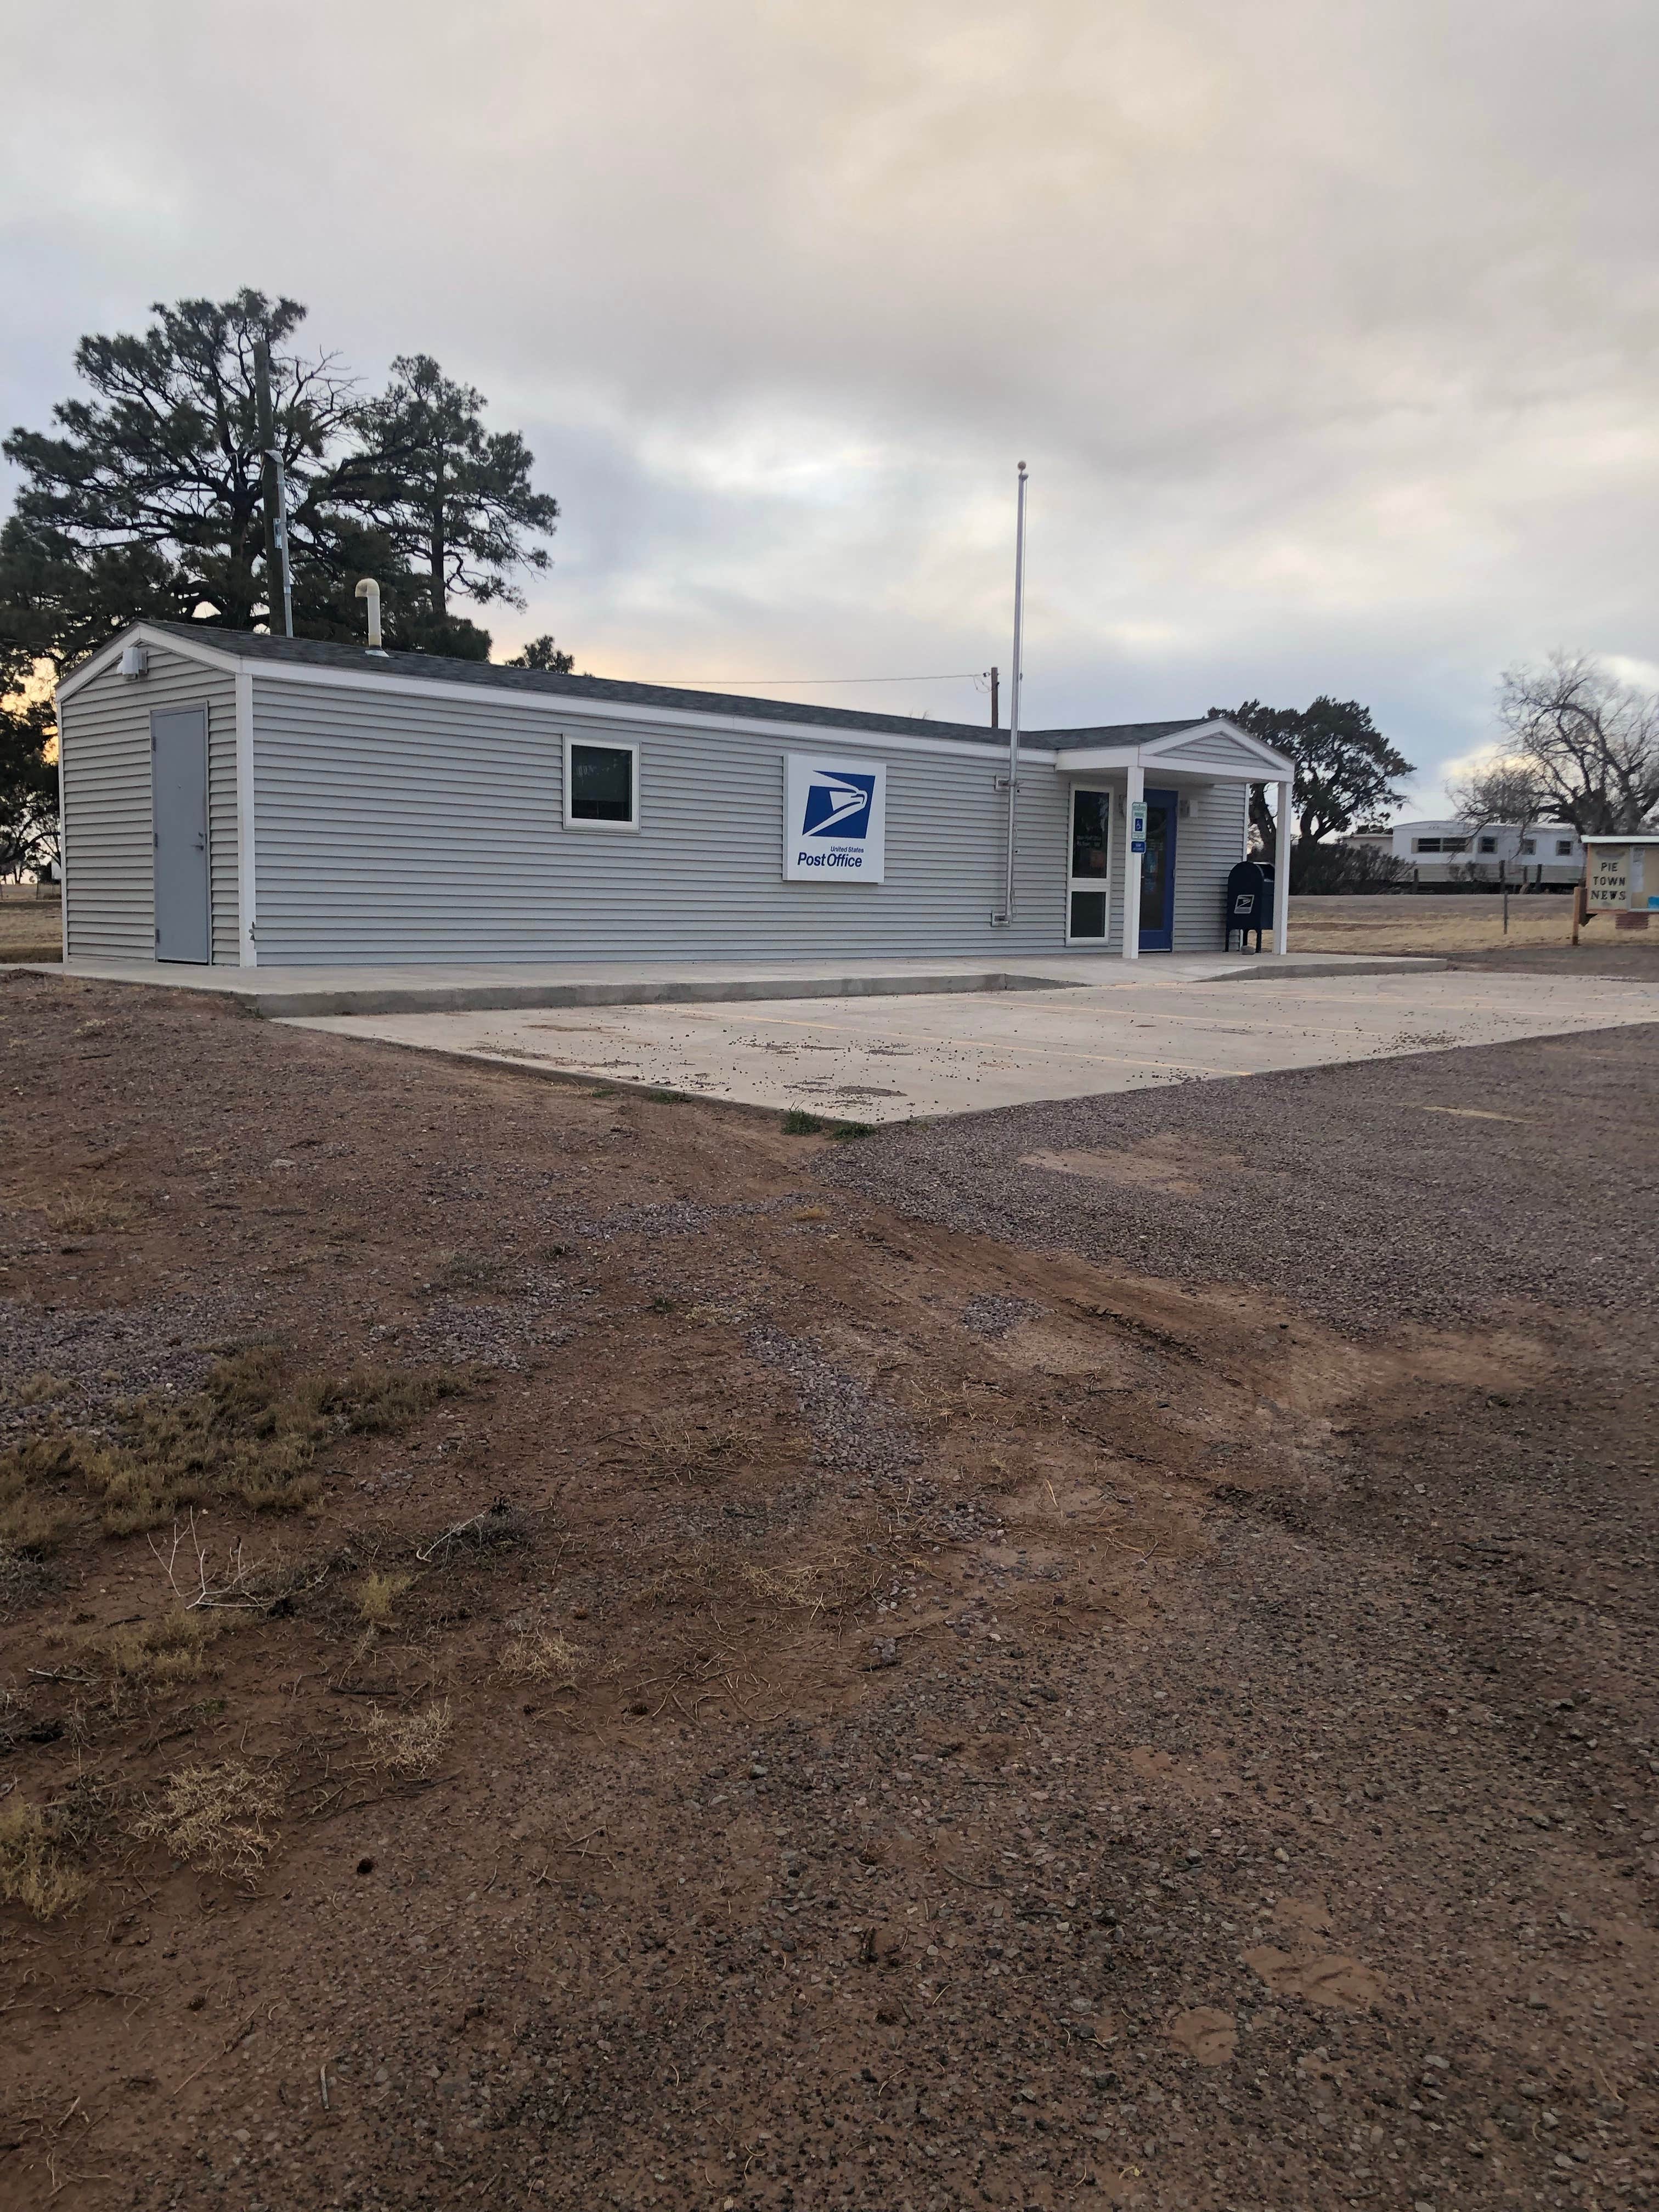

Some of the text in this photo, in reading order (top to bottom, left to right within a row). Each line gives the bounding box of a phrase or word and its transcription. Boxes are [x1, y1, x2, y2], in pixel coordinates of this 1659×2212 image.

[797, 852, 862, 867] Post Office
[1601, 862, 1618, 872] PIE
[1593, 876, 1626, 886] TOWN
[1590, 890, 1626, 900] NEWS
